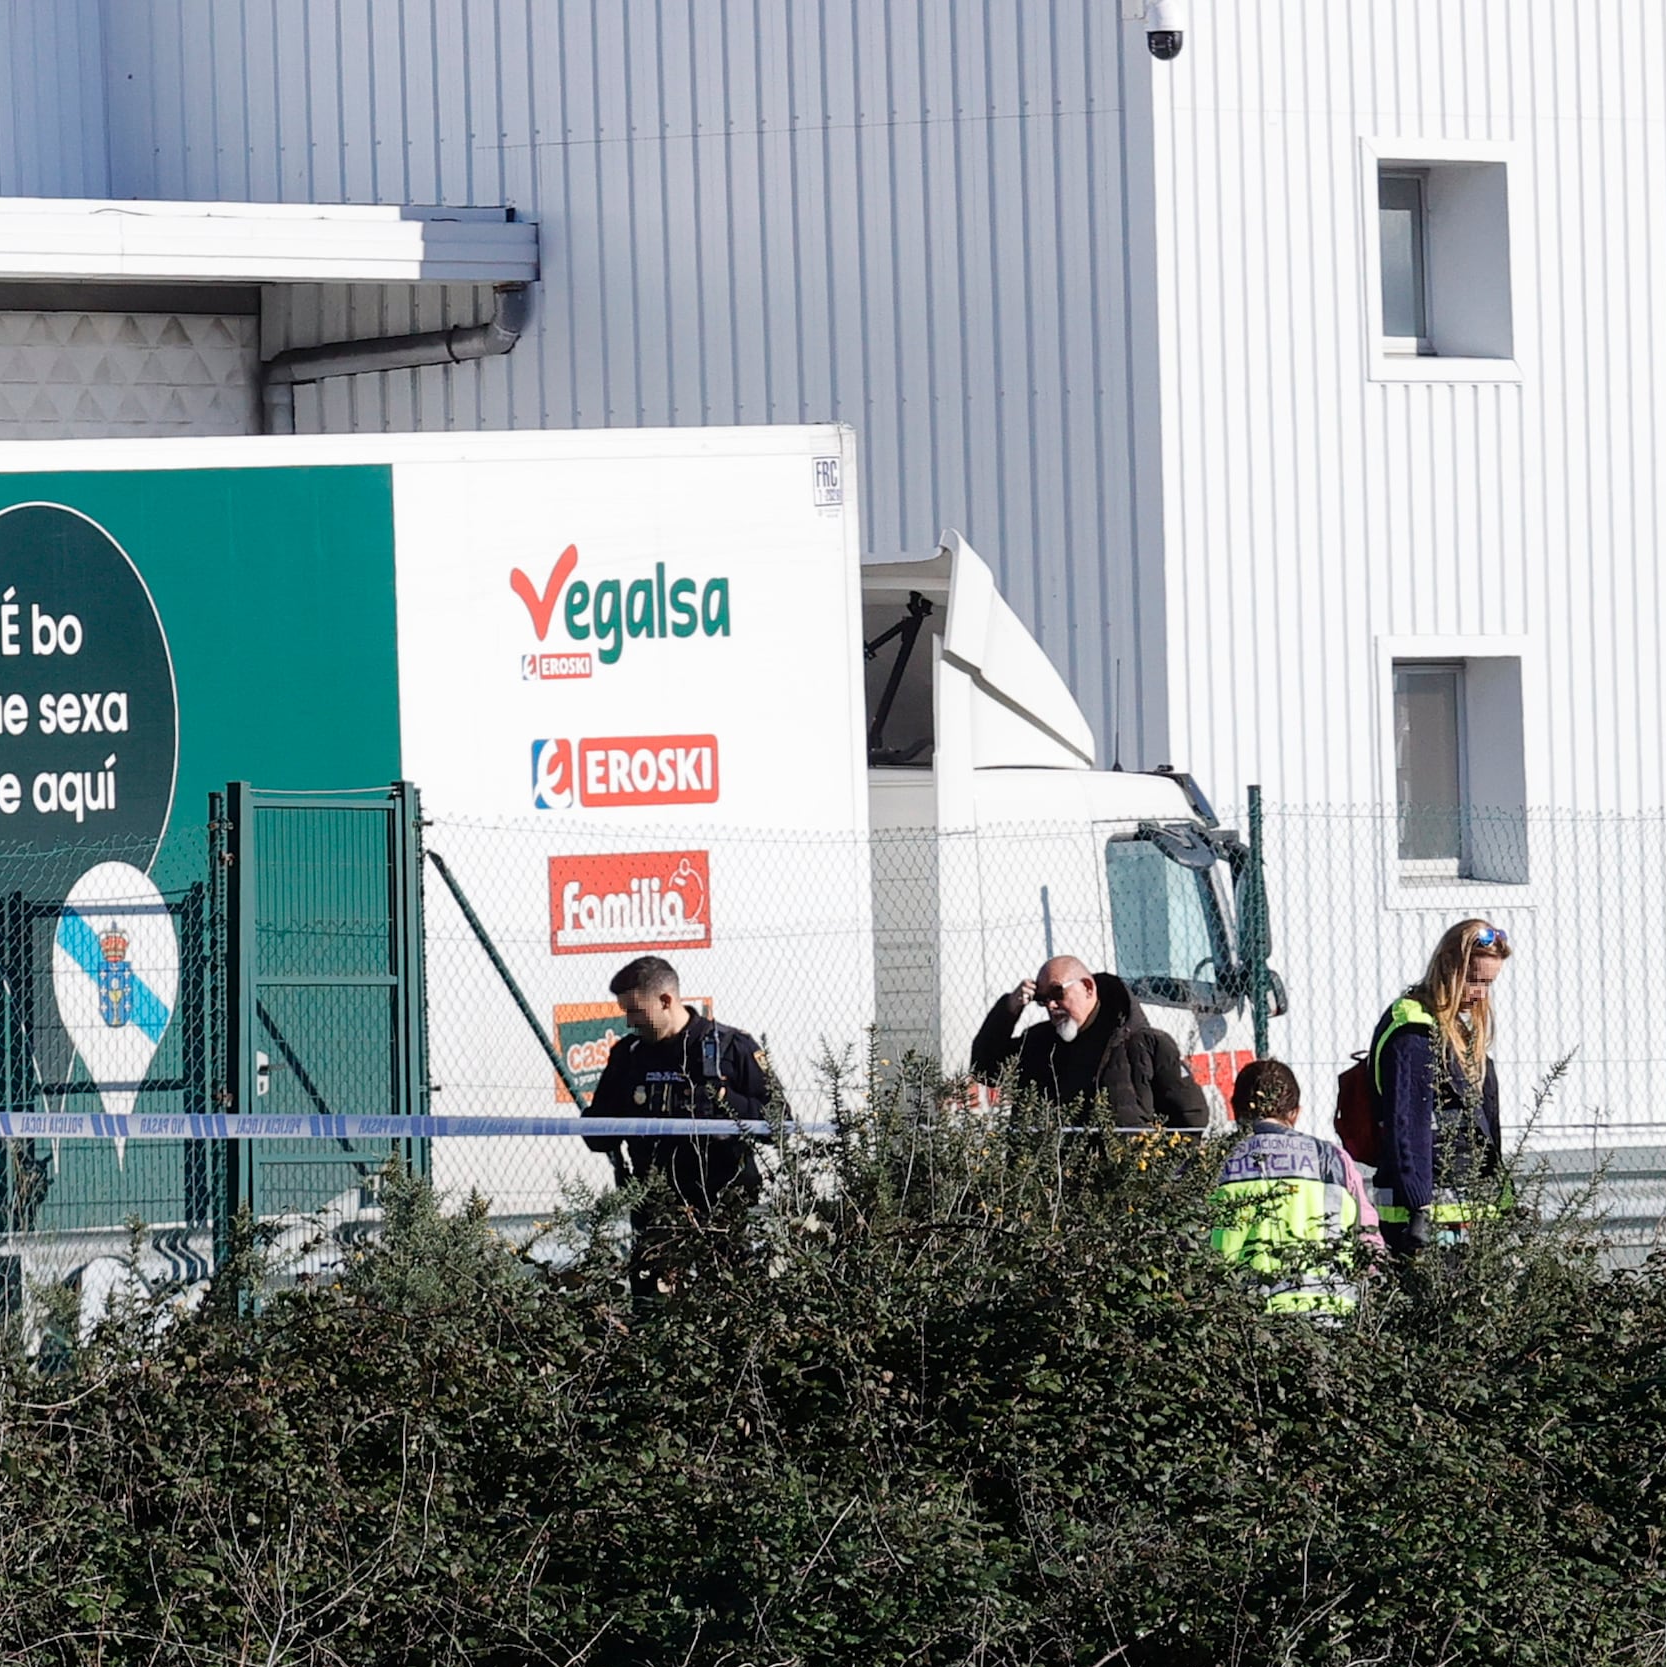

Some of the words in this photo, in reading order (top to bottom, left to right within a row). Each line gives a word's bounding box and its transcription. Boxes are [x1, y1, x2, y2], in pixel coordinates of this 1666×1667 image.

[816, 460, 838, 488] FRC
[0, 586, 20, 655] É
[32, 603, 83, 655] bo
[510, 544, 730, 665] Vegalsa
[541, 656, 591, 676] EROSKI
[39, 691, 128, 734] sexa
[32, 753, 117, 823] aquí
[585, 746, 713, 795] EROSKI
